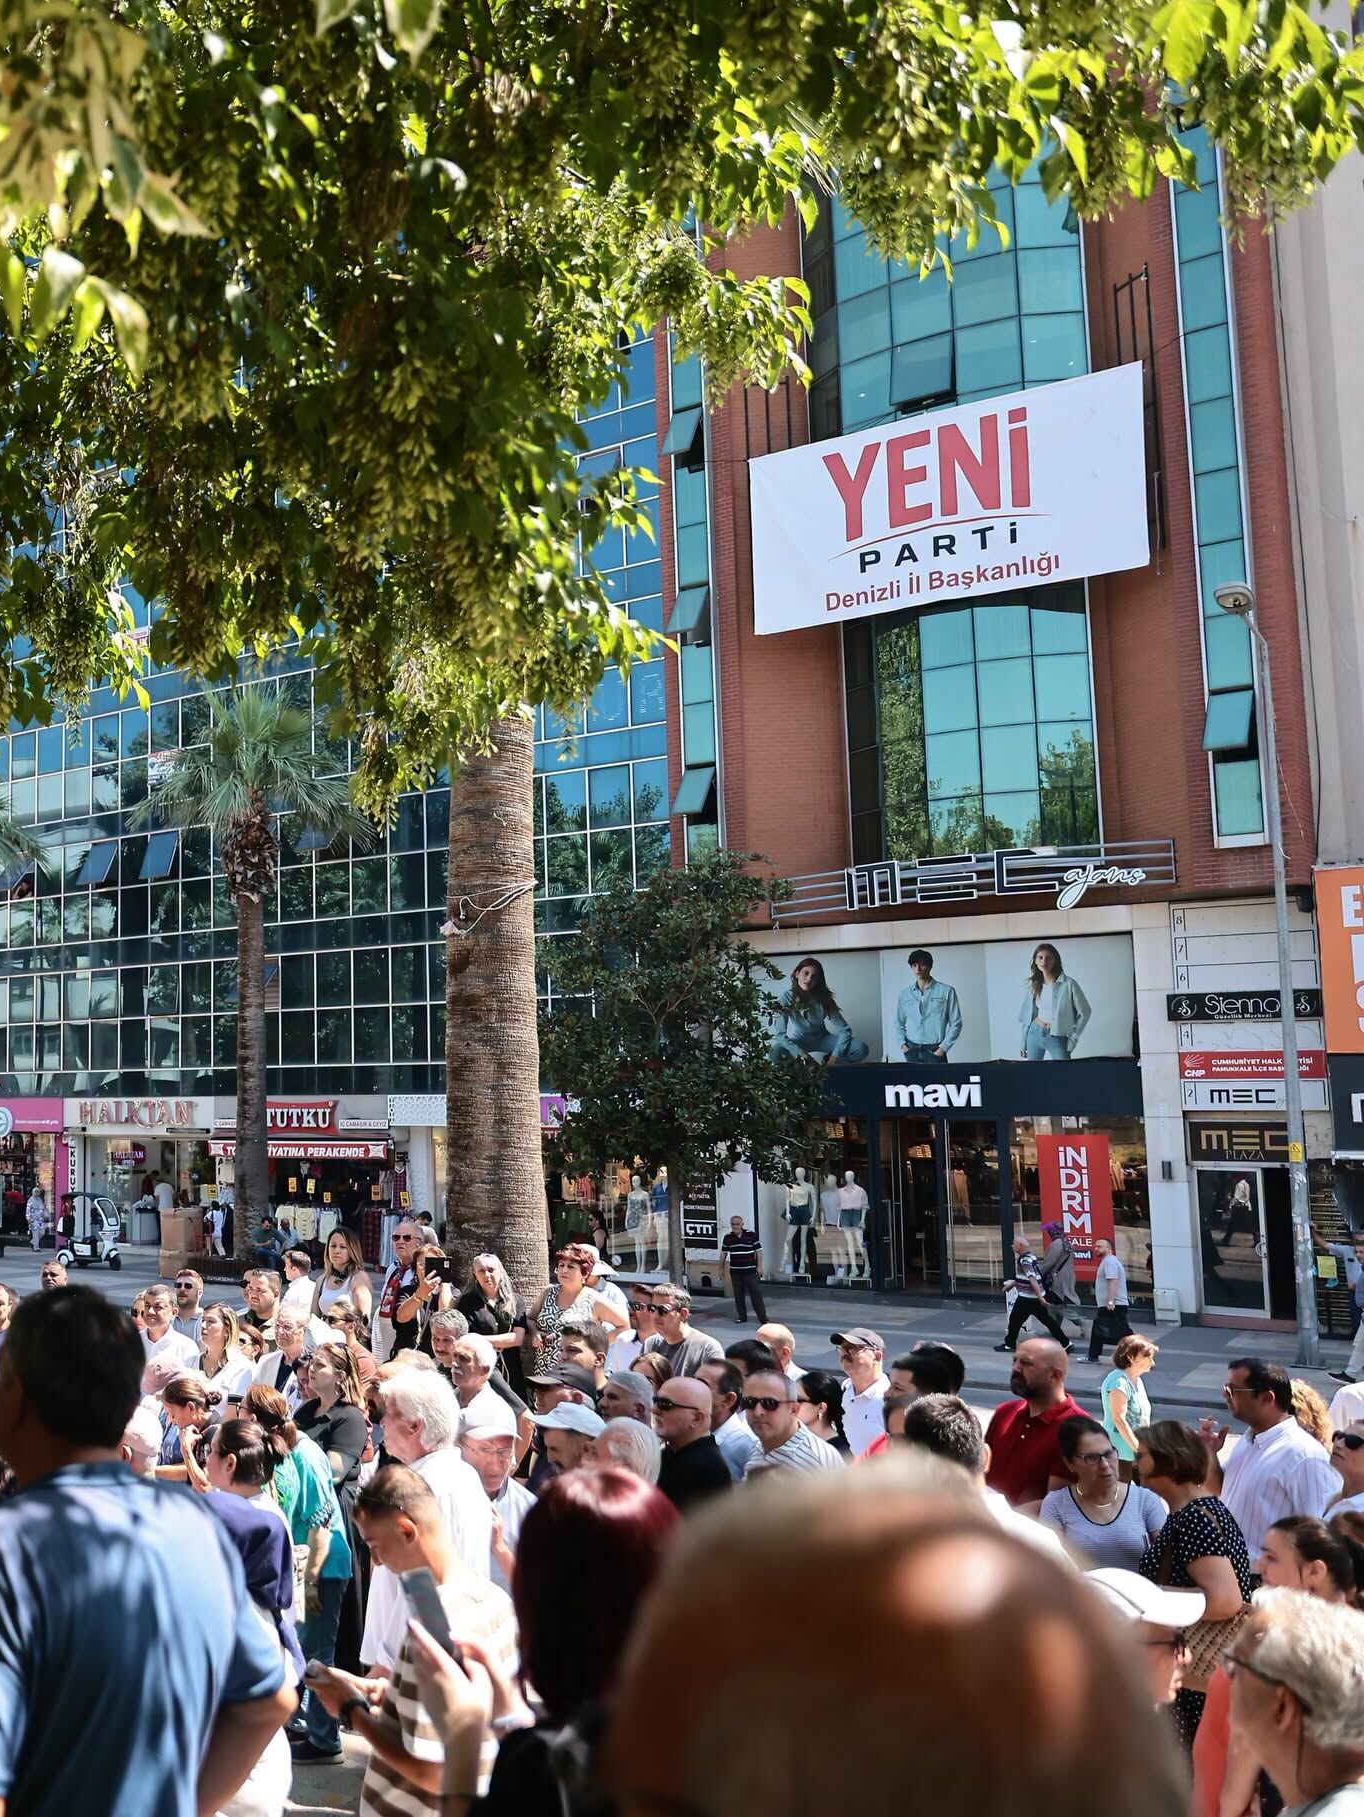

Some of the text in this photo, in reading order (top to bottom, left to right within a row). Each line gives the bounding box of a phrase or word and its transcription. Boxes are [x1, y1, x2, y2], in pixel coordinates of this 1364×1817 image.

[825, 551, 1061, 612] Denizli İl Başkanlığı
[1175, 916, 1183, 925] 8
[1178, 944, 1184, 953] 7
[1179, 973, 1186, 982] 6
[1204, 994, 1281, 1015] Sienna
[1211, 1057, 1261, 1065] CUMHURİYET
[1184, 1069, 1206, 1078] CHP
[1252, 1065, 1268, 1073] İLÇE
[883, 1074, 983, 1108] mavi
[1187, 1088, 1194, 1098] 2
[1209, 1088, 1277, 1104] MEC
[267, 1108, 331, 1128] TUTKU
[267, 1144, 305, 1157] İYATINA
[306, 1146, 365, 1158] PERAKENDE
[1225, 1149, 1266, 1161] PLAZA
